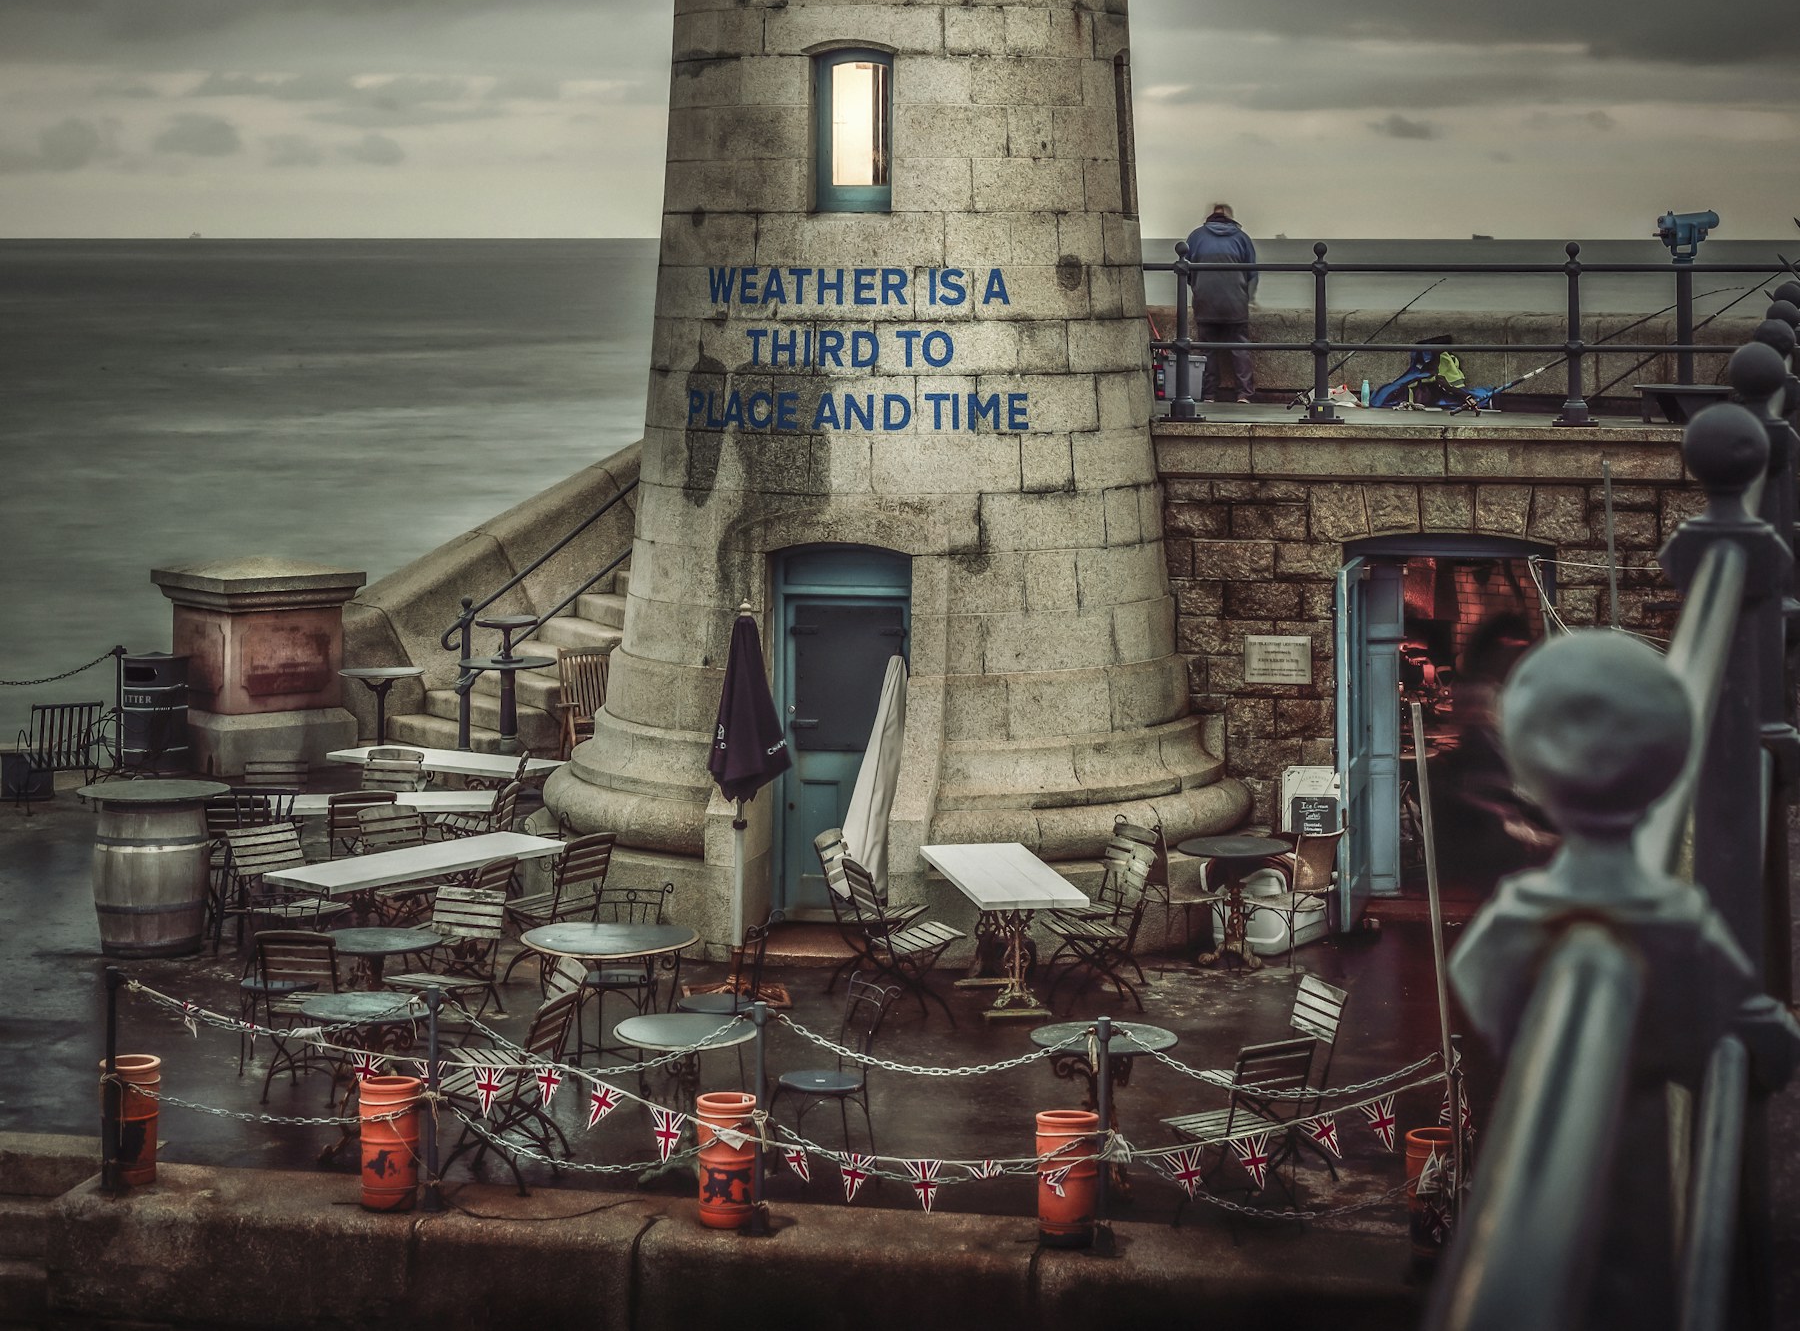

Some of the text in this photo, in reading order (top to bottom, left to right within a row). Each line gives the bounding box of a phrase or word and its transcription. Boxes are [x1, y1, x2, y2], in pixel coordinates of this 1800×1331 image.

[709, 267, 1010, 306] WEATHER IS A
[746, 329, 954, 368] THIRD TO
[688, 391, 1029, 431] PLACE AND TIME
[125, 695, 152, 703] ITTER
